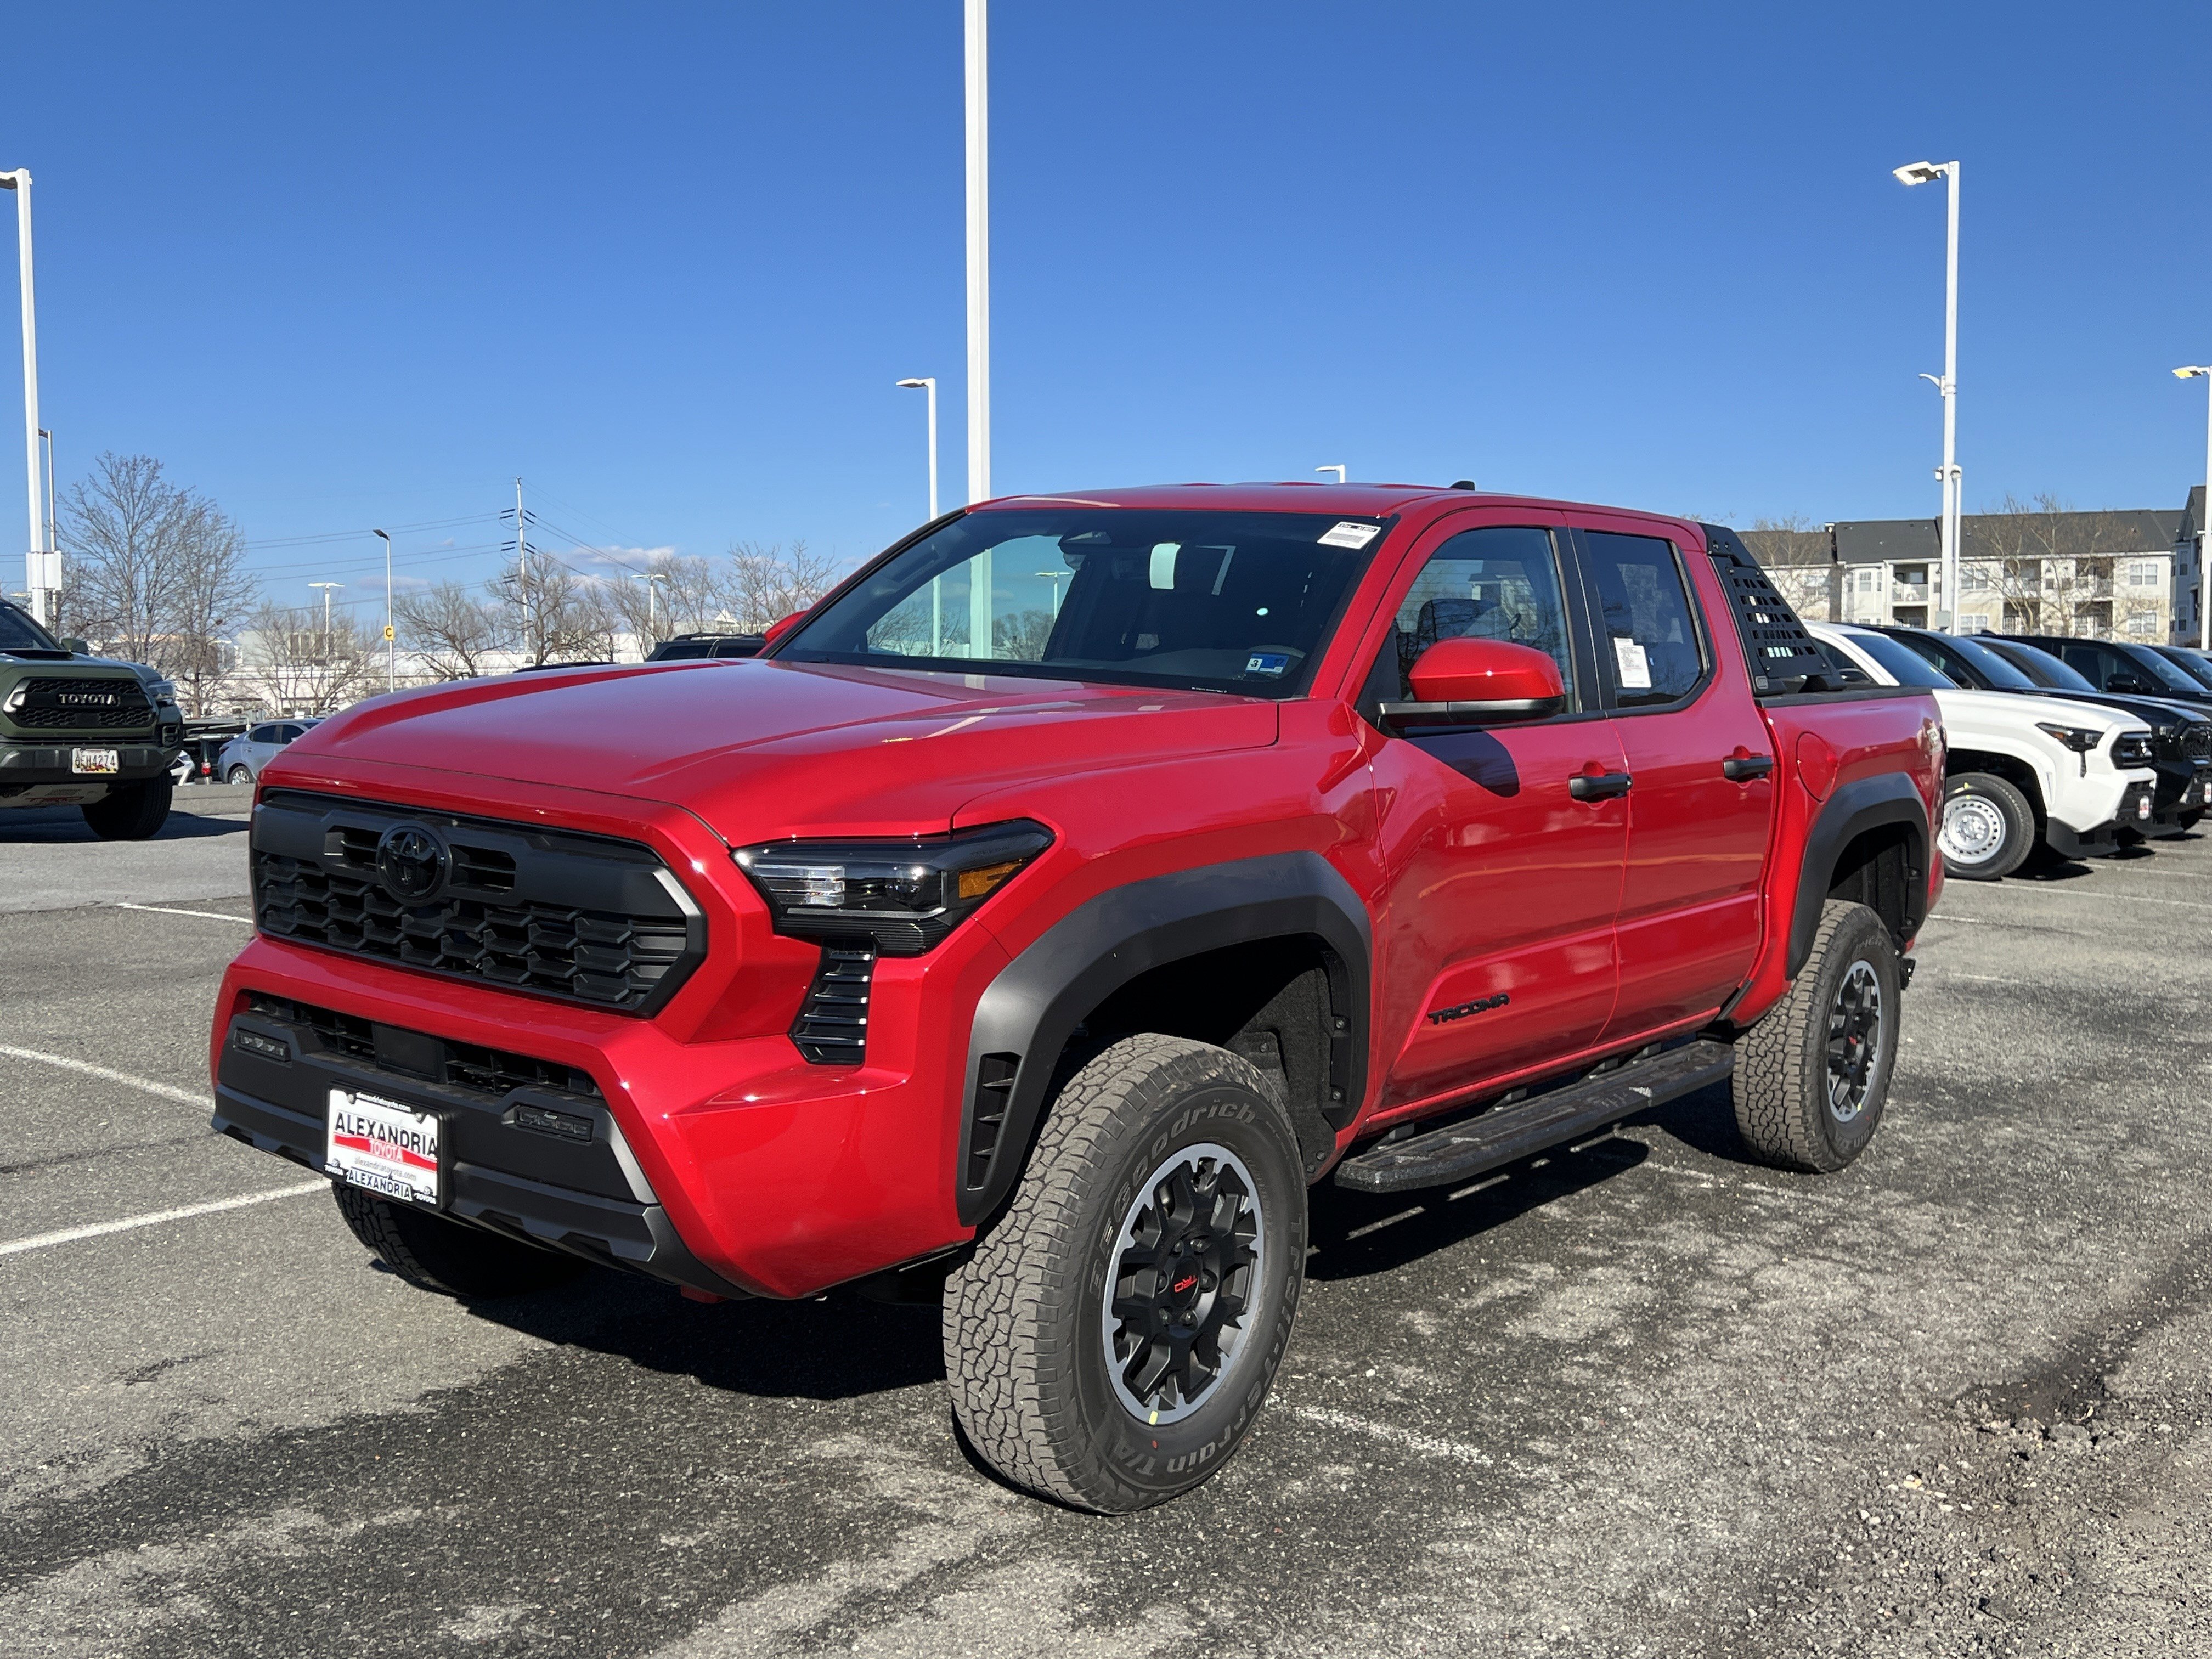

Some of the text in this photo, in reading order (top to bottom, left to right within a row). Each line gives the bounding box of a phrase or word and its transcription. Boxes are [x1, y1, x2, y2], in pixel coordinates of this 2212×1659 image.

[386, 628, 392, 637] C
[59, 693, 117, 705] TOYOTA
[1427, 992, 1510, 1025] TACOMA
[335, 1112, 437, 1158] ALEXANDRIA
[369, 1140, 403, 1162] TOYOTA
[347, 1169, 411, 1199] ALEXANDRIA
[1174, 1274, 1198, 1293] TRD
